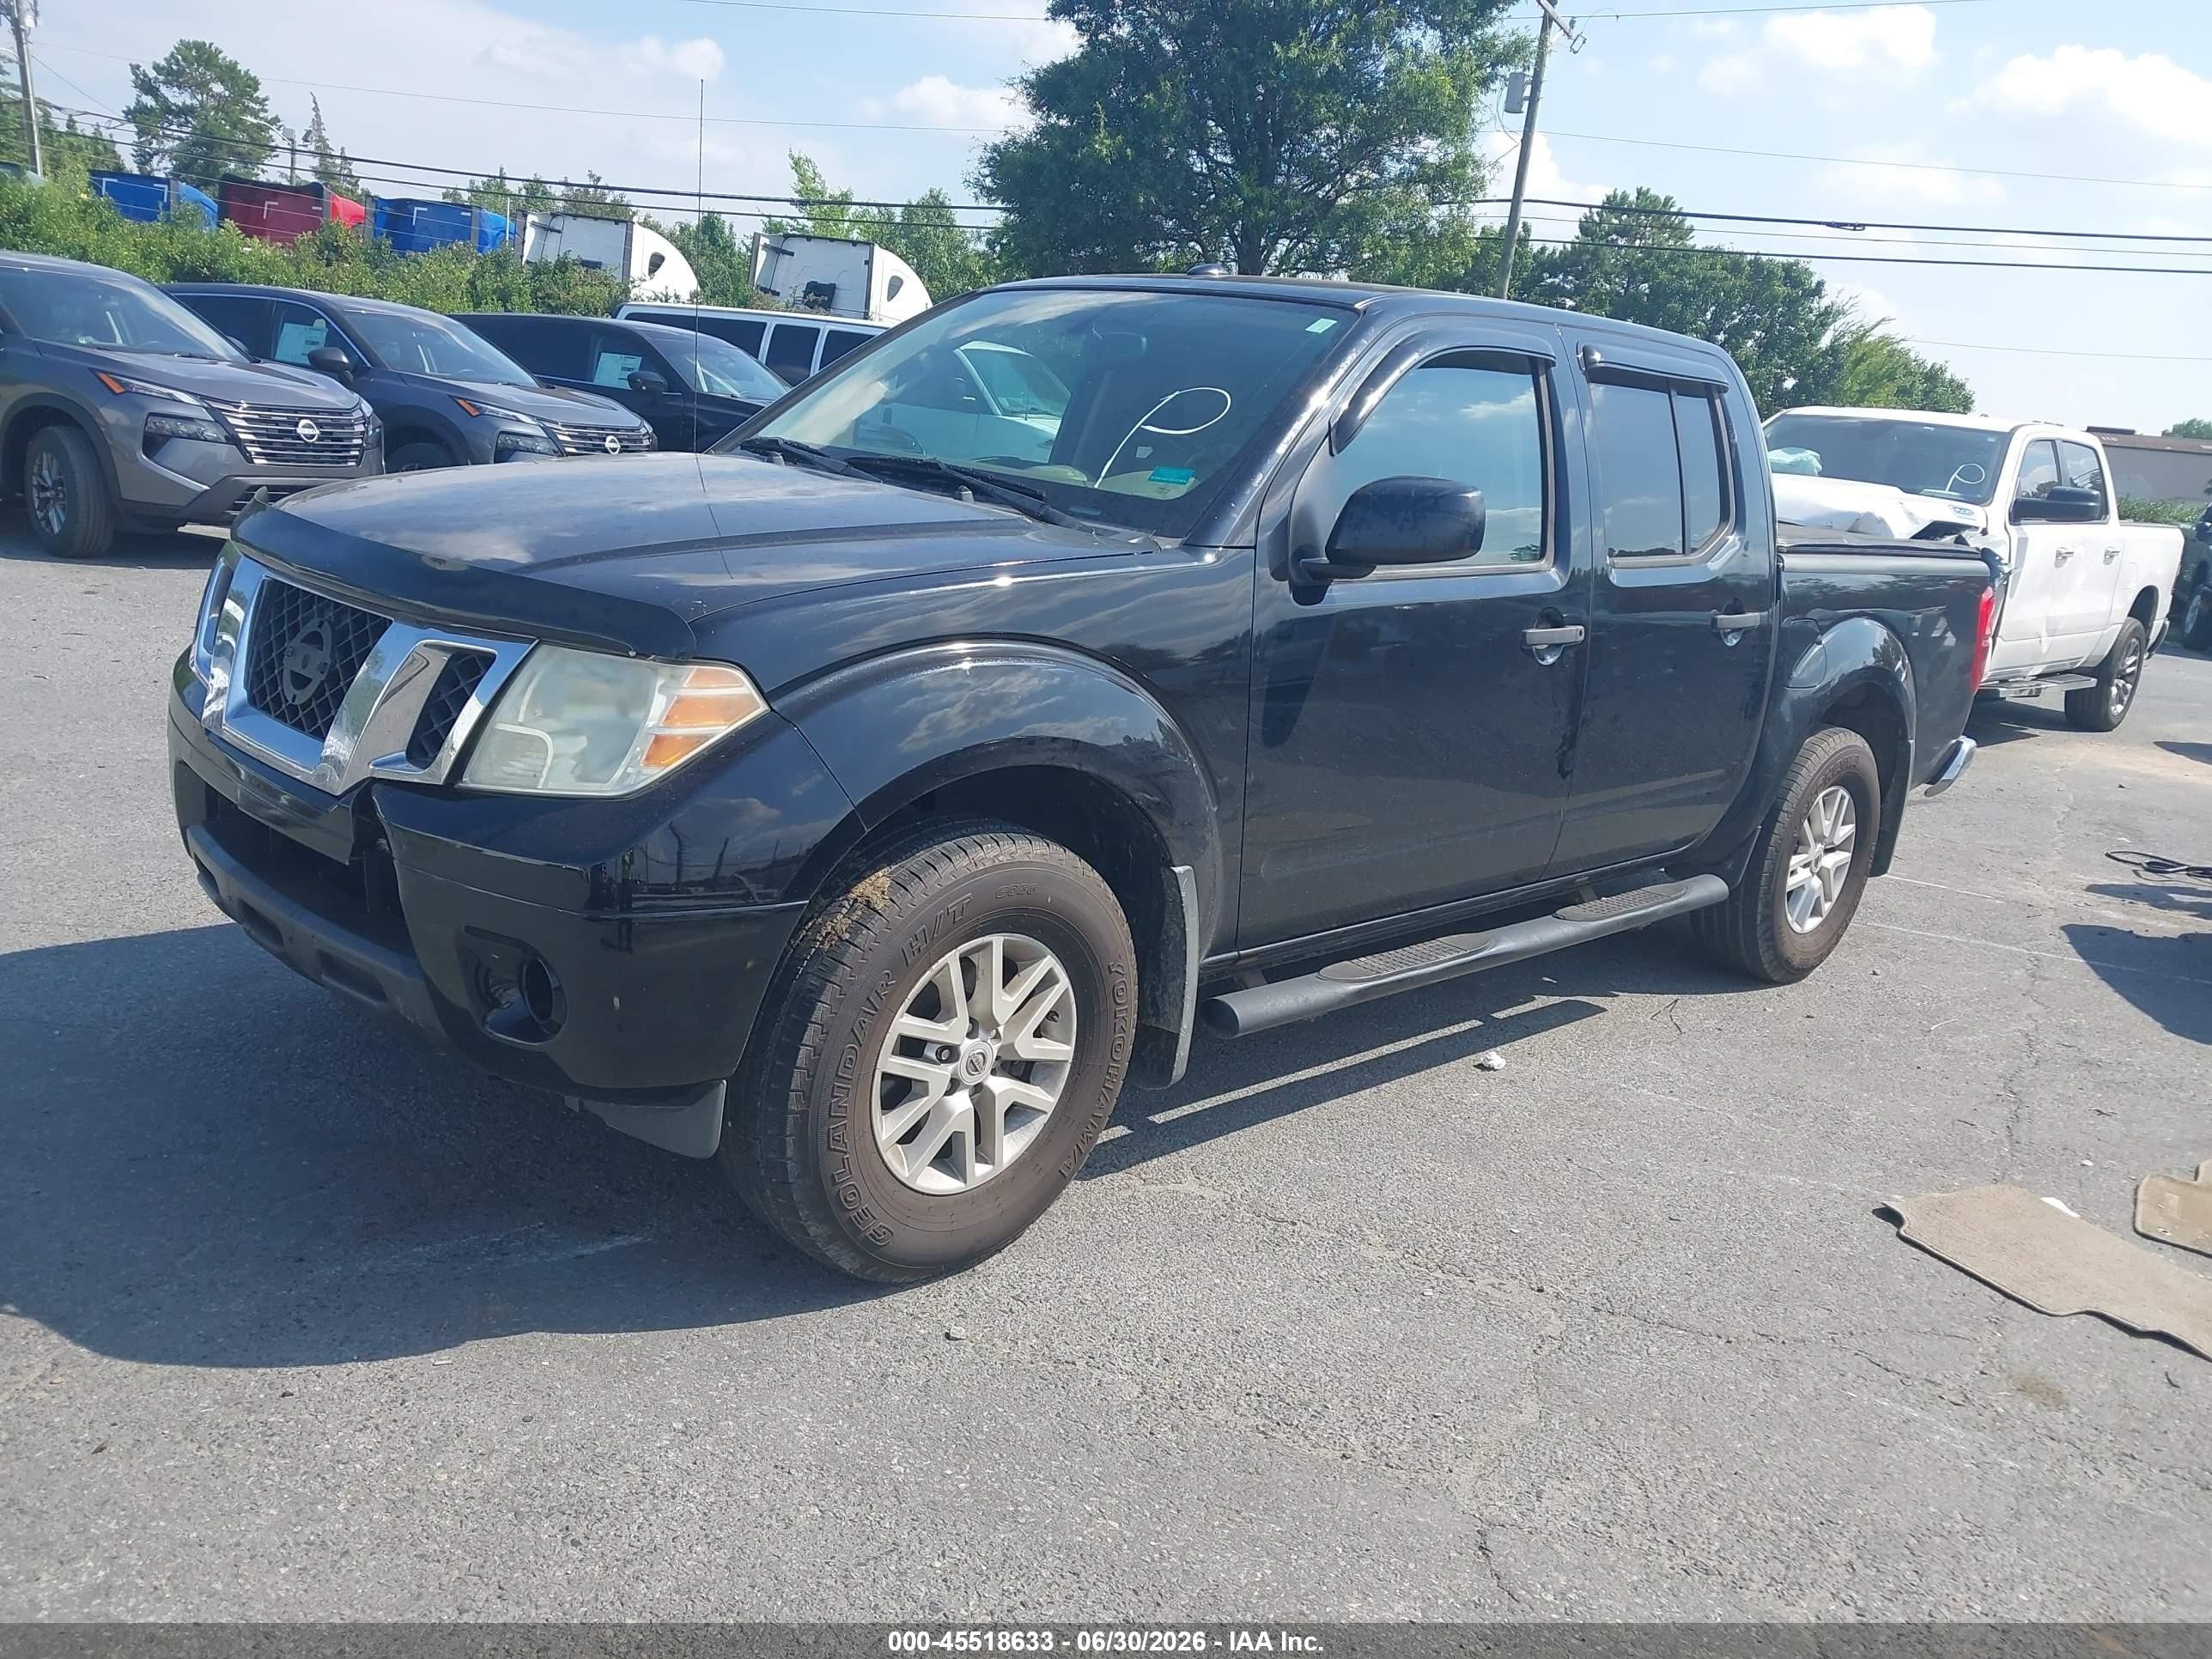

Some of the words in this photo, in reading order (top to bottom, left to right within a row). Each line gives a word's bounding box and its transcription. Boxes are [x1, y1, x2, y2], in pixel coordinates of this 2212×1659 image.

[828, 969, 897, 1246] GEOLANDAR
[902, 892, 974, 967] H/T
[1058, 961, 1128, 1180] YOKOHAMA
